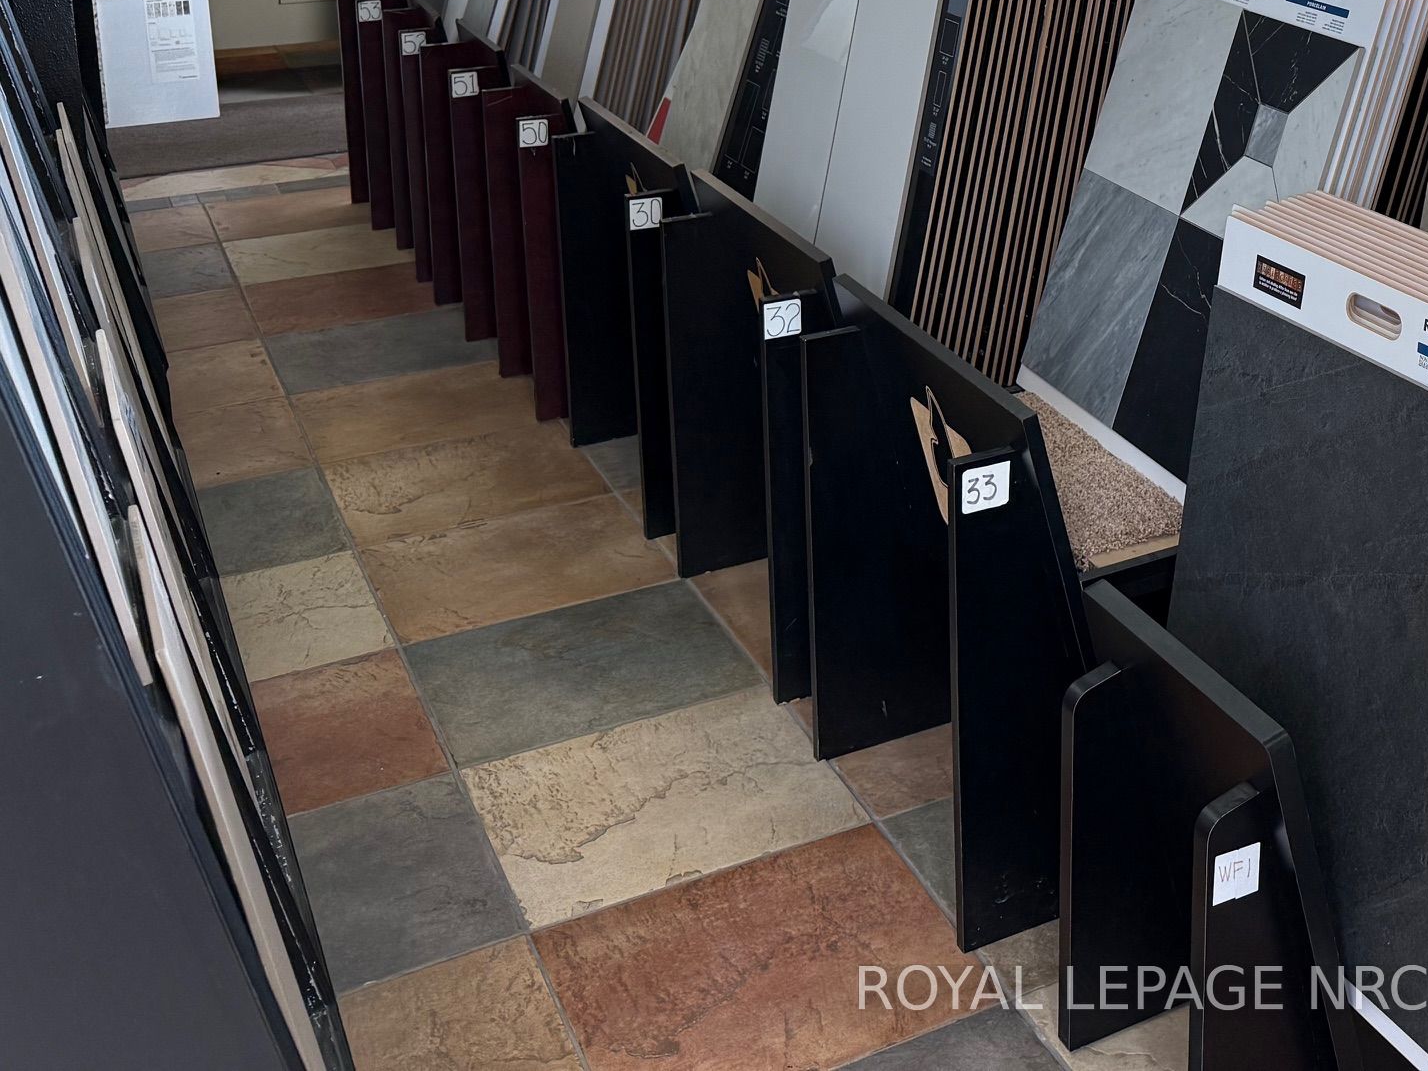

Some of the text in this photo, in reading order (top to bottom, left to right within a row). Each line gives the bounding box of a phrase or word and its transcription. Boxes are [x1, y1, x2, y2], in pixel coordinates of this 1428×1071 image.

[360, 1, 381, 22] 53
[402, 33, 426, 55] 52
[453, 73, 478, 96] 51
[522, 121, 548, 145] 50
[632, 198, 662, 228] 30
[766, 302, 801, 338] 32
[966, 473, 998, 505] 33
